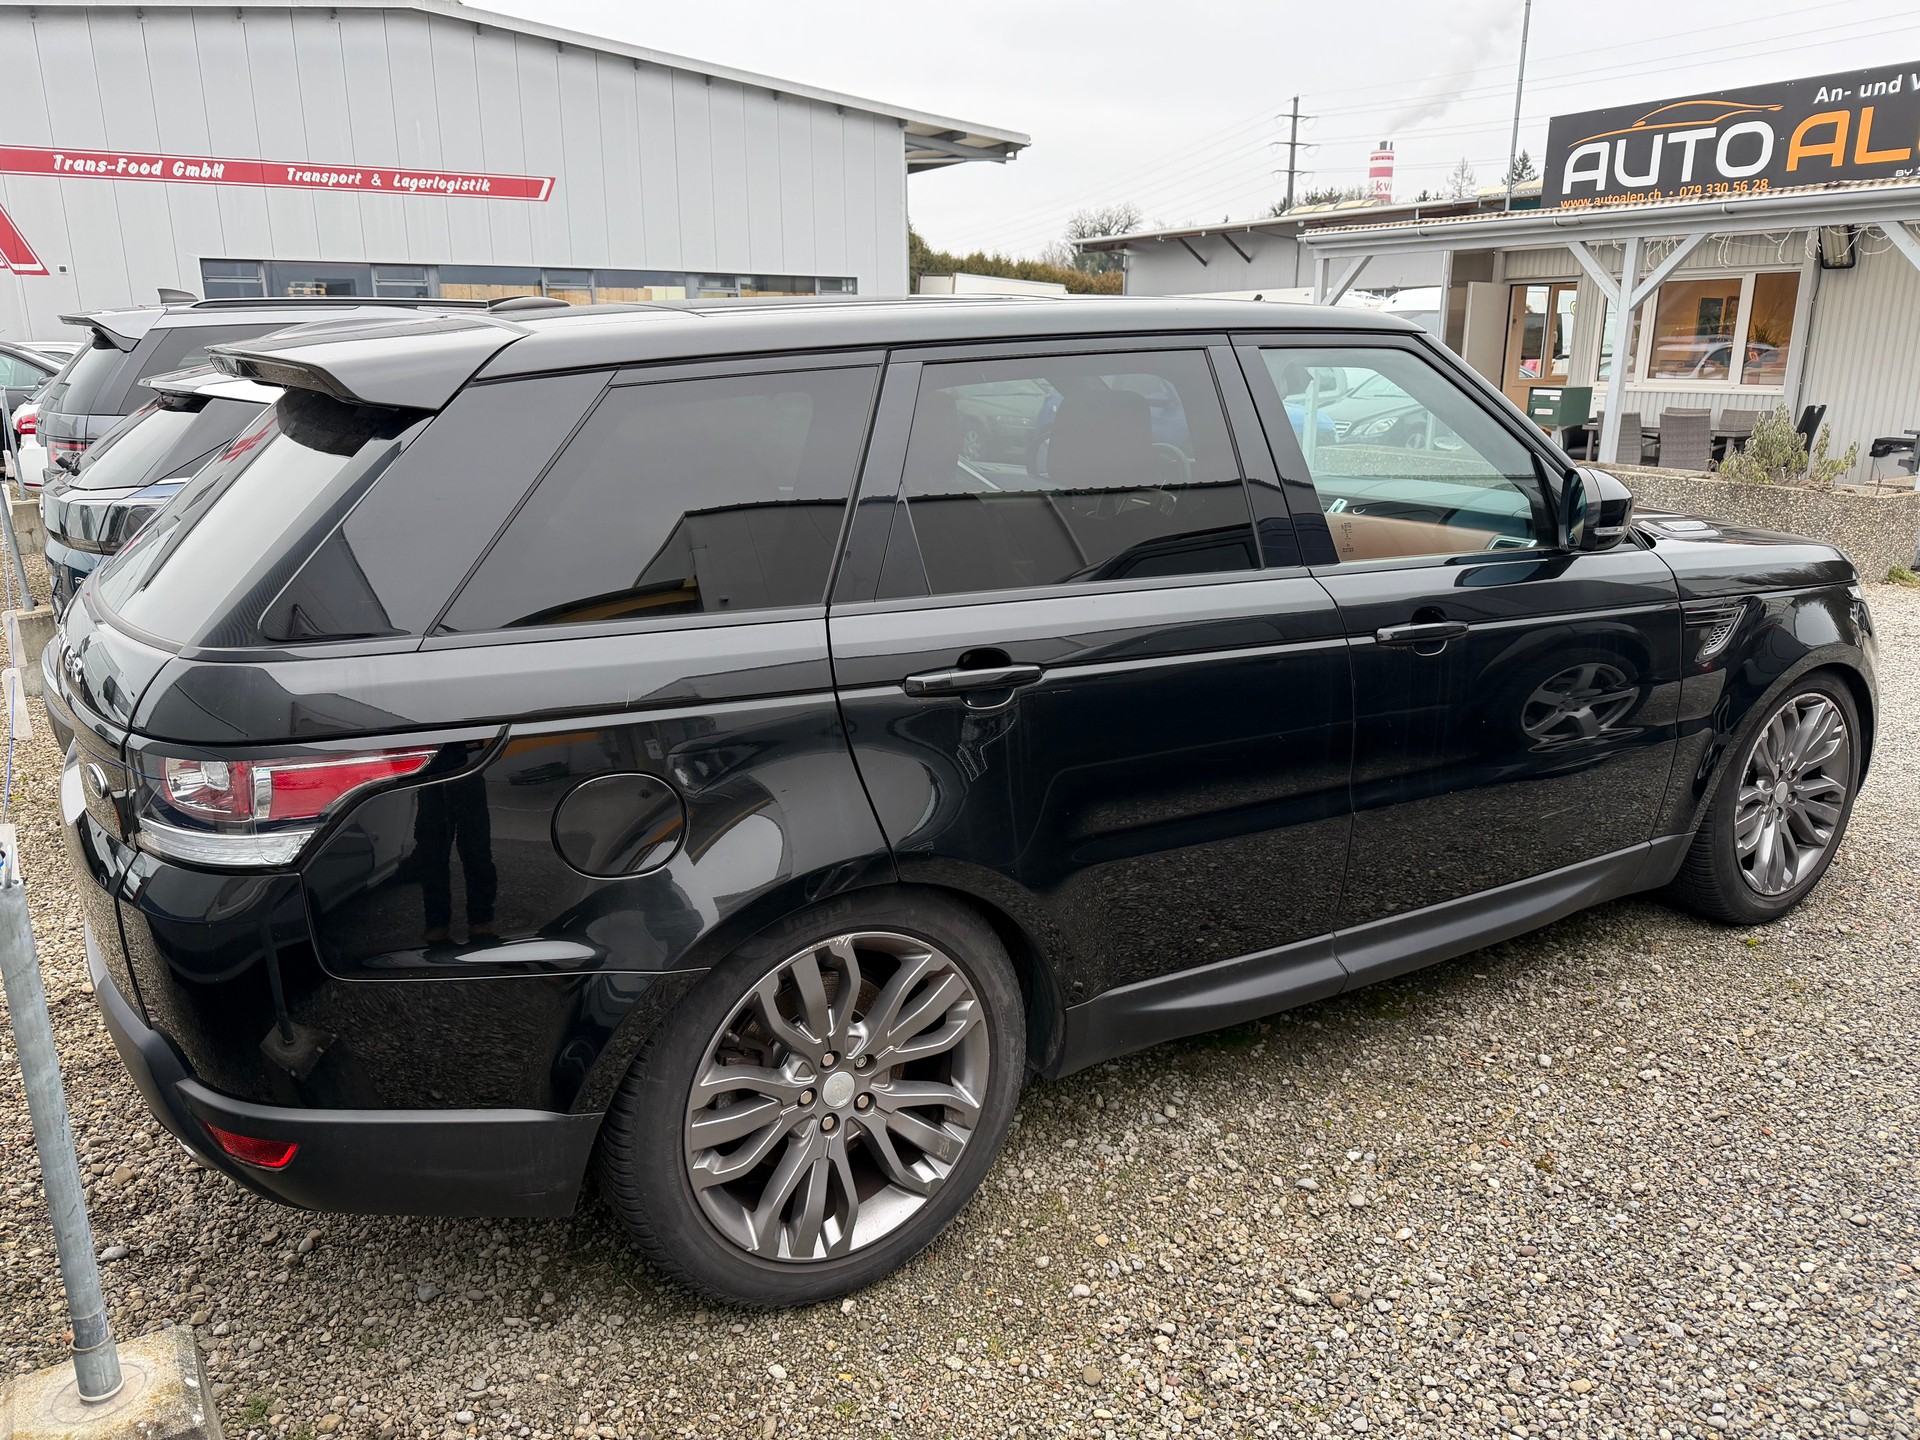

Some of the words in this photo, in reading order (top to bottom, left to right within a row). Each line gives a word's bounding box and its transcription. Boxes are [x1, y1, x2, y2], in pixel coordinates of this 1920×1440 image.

[1812, 86, 1852, 105] An-
[1859, 73, 1903, 98] und
[1561, 121, 1775, 195] AUTO
[1786, 106, 1920, 172] AL
[53, 154, 163, 176] Trans-Food
[172, 161, 225, 179] GmbH
[286, 167, 362, 187] Transport
[371, 173, 382, 187] &
[393, 173, 490, 193] Lagerlogistik
[1679, 185, 1702, 198] 079
[1706, 182, 1729, 194] 330
[1733, 180, 1748, 193] 56
[1752, 178, 1769, 191] 28
